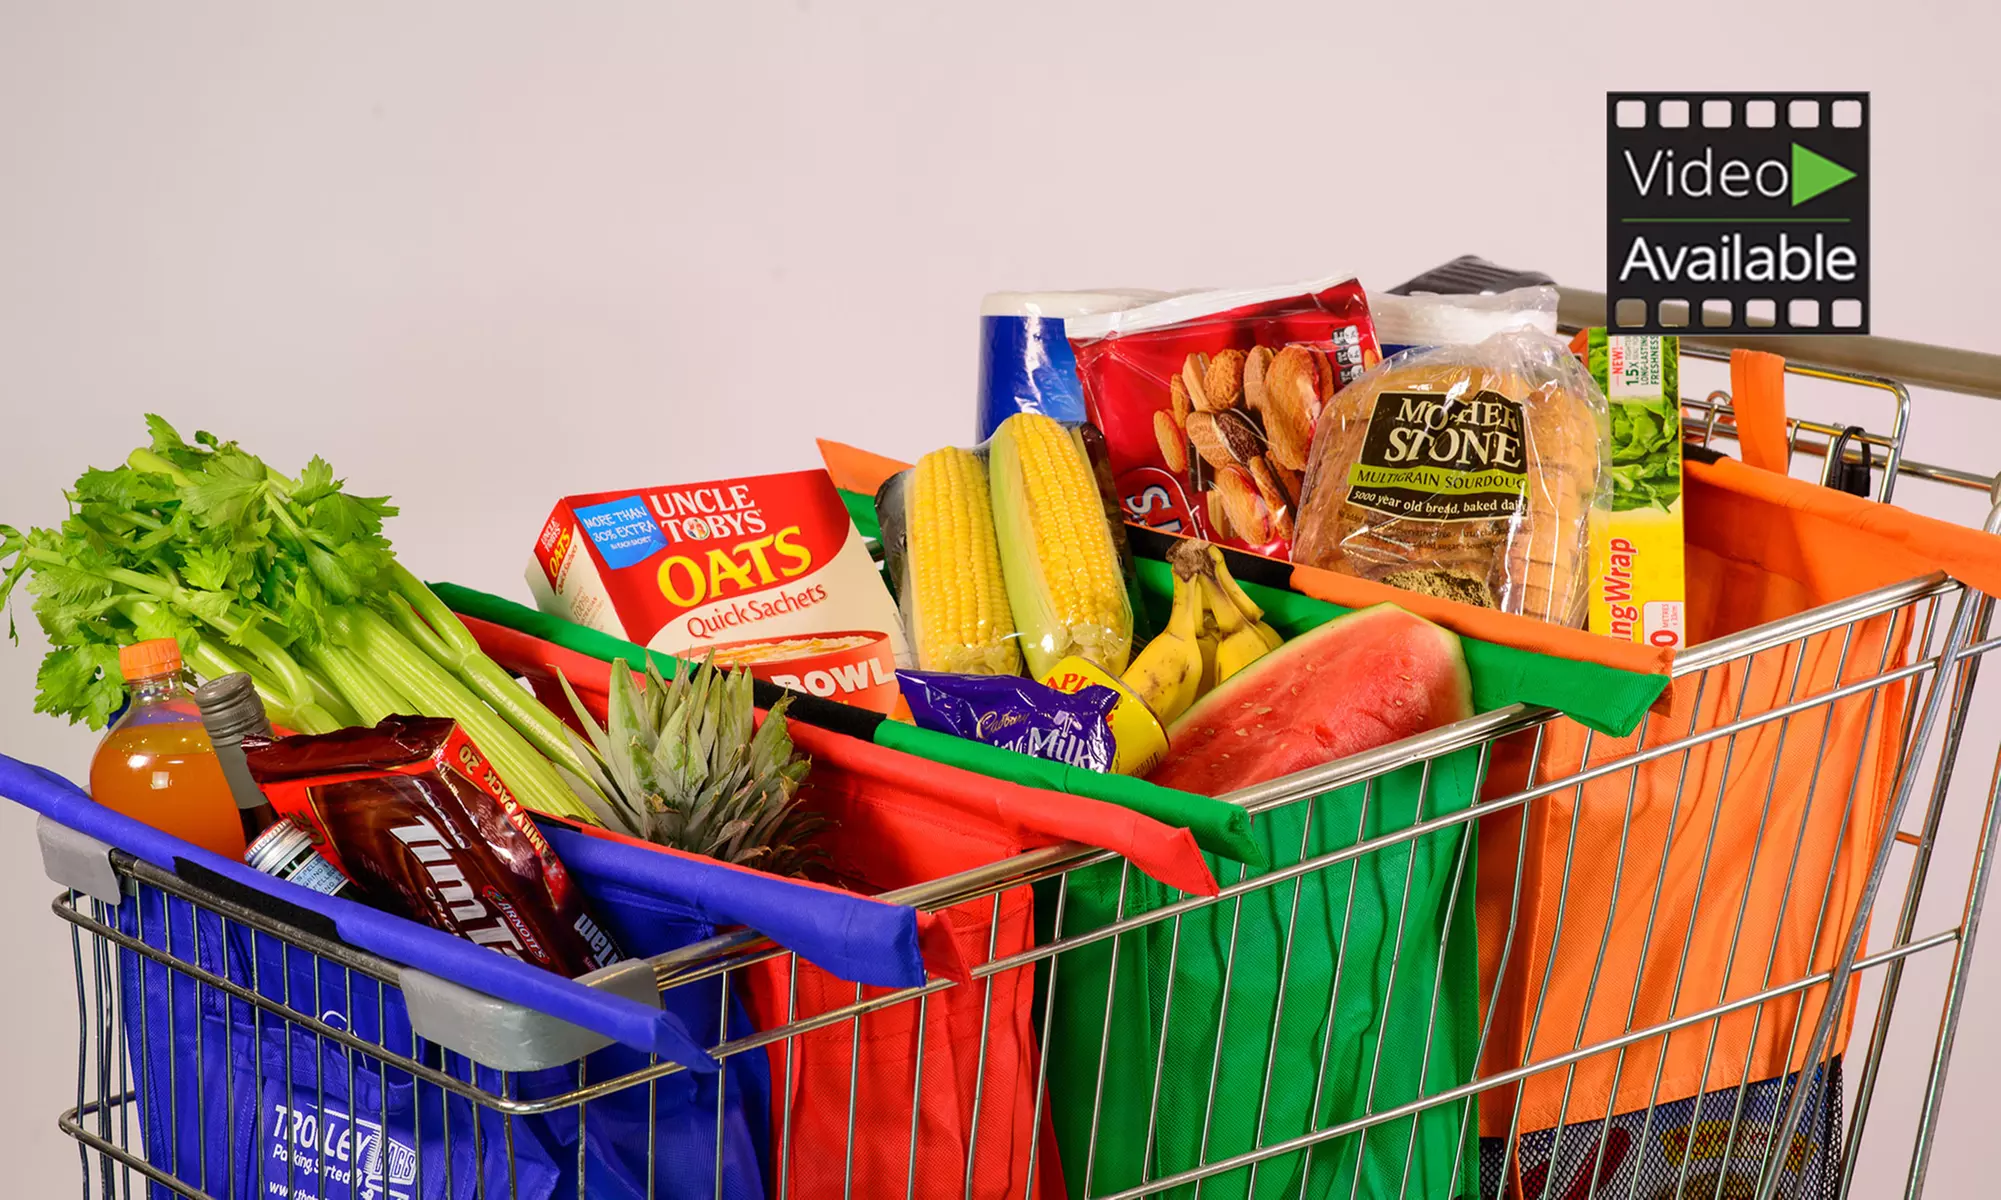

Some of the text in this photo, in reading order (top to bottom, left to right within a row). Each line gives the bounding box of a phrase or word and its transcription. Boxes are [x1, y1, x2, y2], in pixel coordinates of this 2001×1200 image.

[1611, 345, 1623, 375] NEW!
[1395, 397, 1518, 432] MOHER
[1384, 427, 1521, 468] STONE
[1357, 469, 1440, 487] MULTIGRAIN
[583, 506, 647, 528] MORE THAN
[649, 484, 755, 518] UNCLE
[1353, 490, 1376, 502] 5000
[1376, 494, 1401, 508] year
[1403, 500, 1421, 513] old
[1425, 502, 1460, 515] bread,
[1463, 500, 1497, 512] baked
[592, 519, 657, 543] 30% EXTRA
[661, 510, 766, 543] TOBYS
[549, 528, 571, 578] OATS
[656, 525, 812, 608] OATS
[1604, 538, 1637, 602] Wrap
[686, 584, 828, 640] Quick Sachets
[977, 709, 1030, 739] Cadbury
[459, 745, 480, 776] 20
[1029, 727, 1092, 767] Milk
[483, 769, 518, 815] PACK
[388, 815, 488, 923] Tim
[273, 1104, 373, 1164] TROLEY
[313, 1158, 351, 1185] Srted
